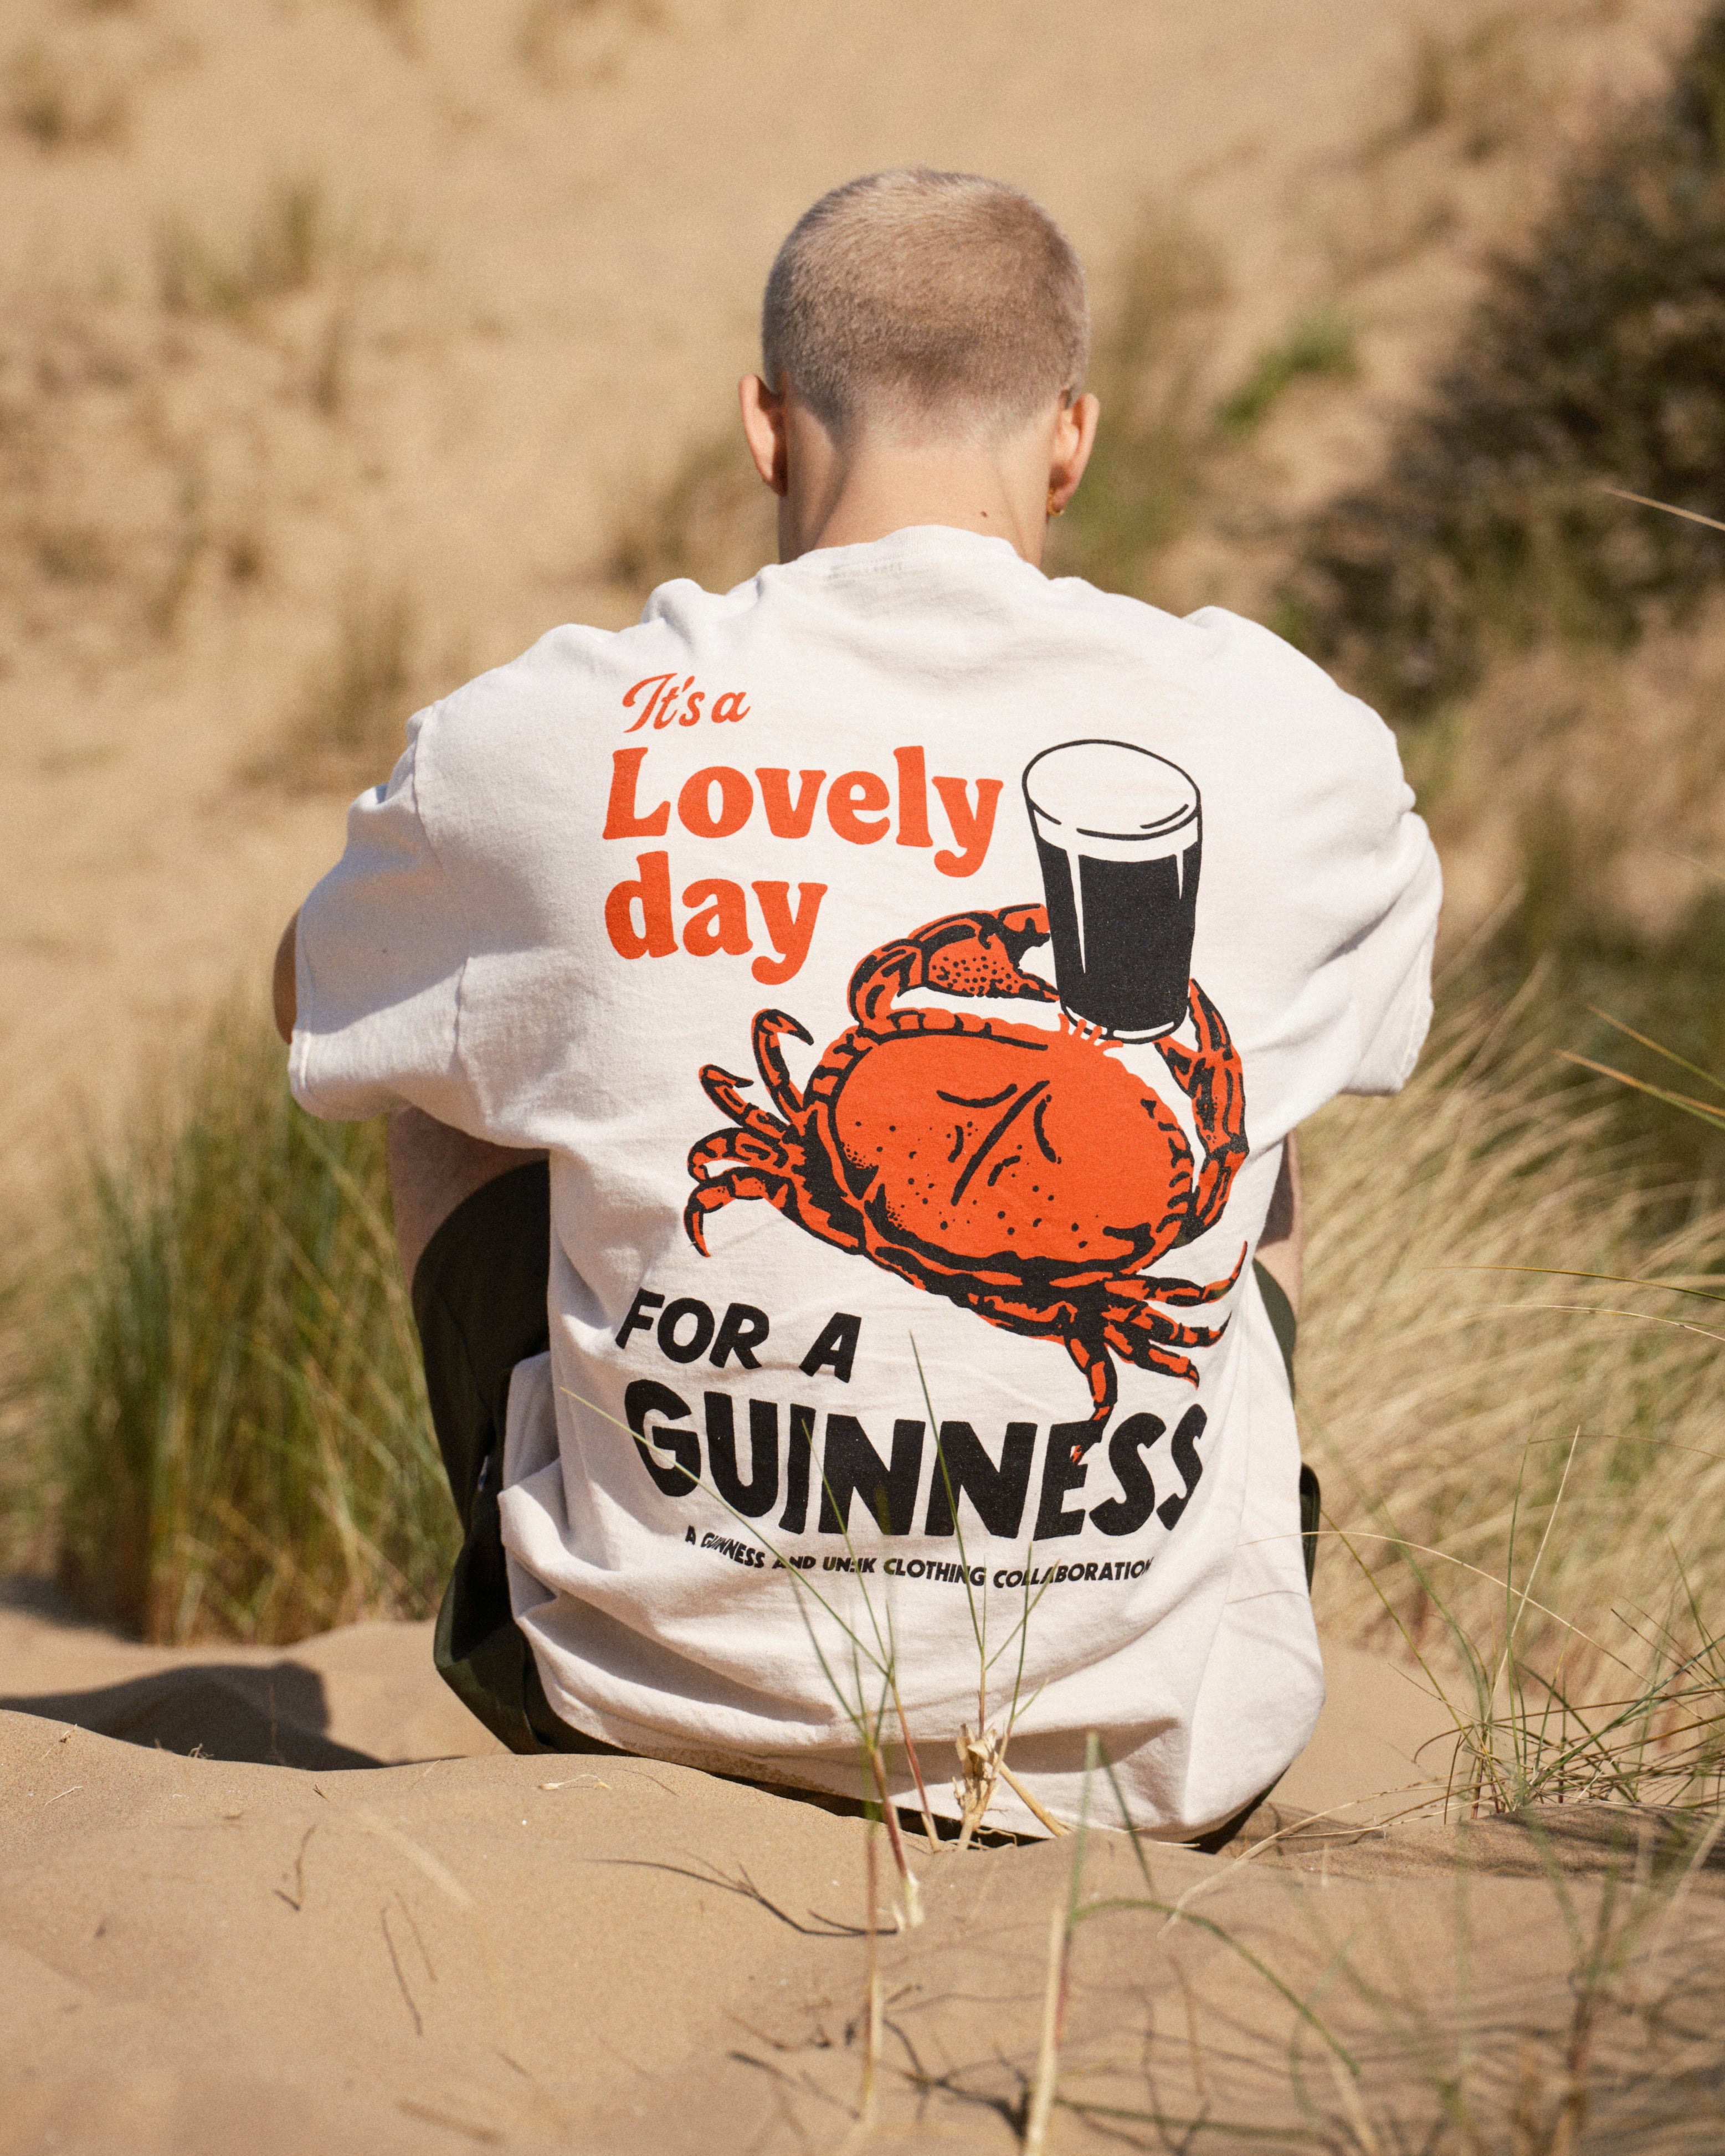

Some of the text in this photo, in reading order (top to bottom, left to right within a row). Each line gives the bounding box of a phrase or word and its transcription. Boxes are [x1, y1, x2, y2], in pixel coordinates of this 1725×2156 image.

[622, 672, 751, 733] It's a
[602, 745, 1004, 878] Lovely
[604, 850, 828, 986] day
[615, 1287, 862, 1383] FOR A
[624, 1378, 1208, 1541] GUINNESS
[685, 1525, 696, 1545] A
[700, 1532, 766, 1568] GUINNESS
[772, 1556, 817, 1570] AND
[883, 1558, 987, 1586] CLOTHING
